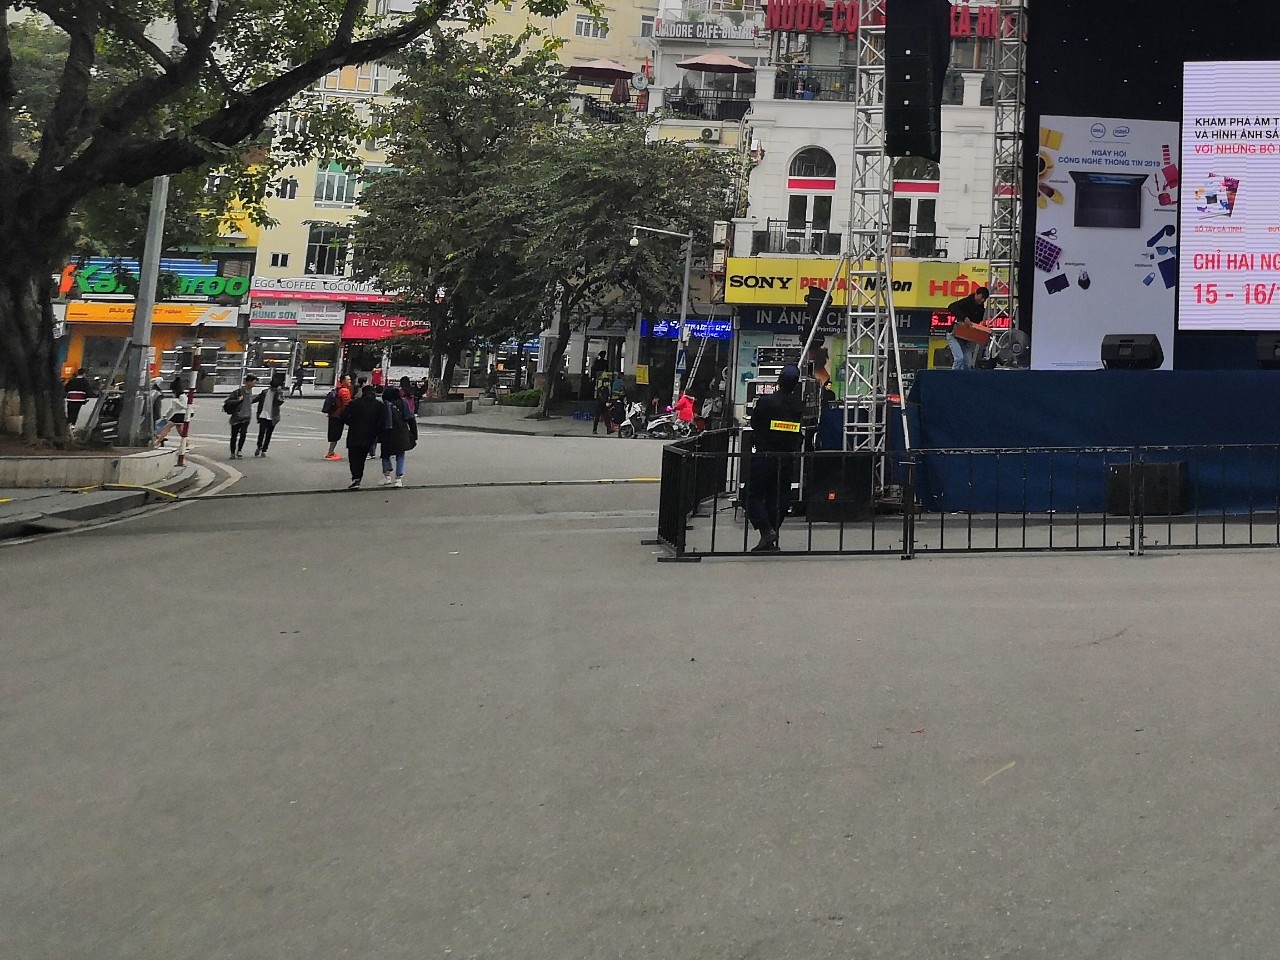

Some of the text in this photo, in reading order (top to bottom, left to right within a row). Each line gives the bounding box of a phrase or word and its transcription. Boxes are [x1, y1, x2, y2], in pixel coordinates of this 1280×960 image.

[1193, 249, 1221, 271] CHỈ
[1226, 253, 1254, 271] HAI
[254, 279, 276, 289] EGG
[279, 280, 317, 291] COFFEE
[323, 282, 372, 292] COCONUT
[729, 275, 793, 290] SONY
[1193, 283, 1218, 304] 15
[352, 318, 369, 327] THE
[371, 319, 396, 328] NOTE
[756, 310, 773, 324] IN
[816, 325, 841, 335] Printing
